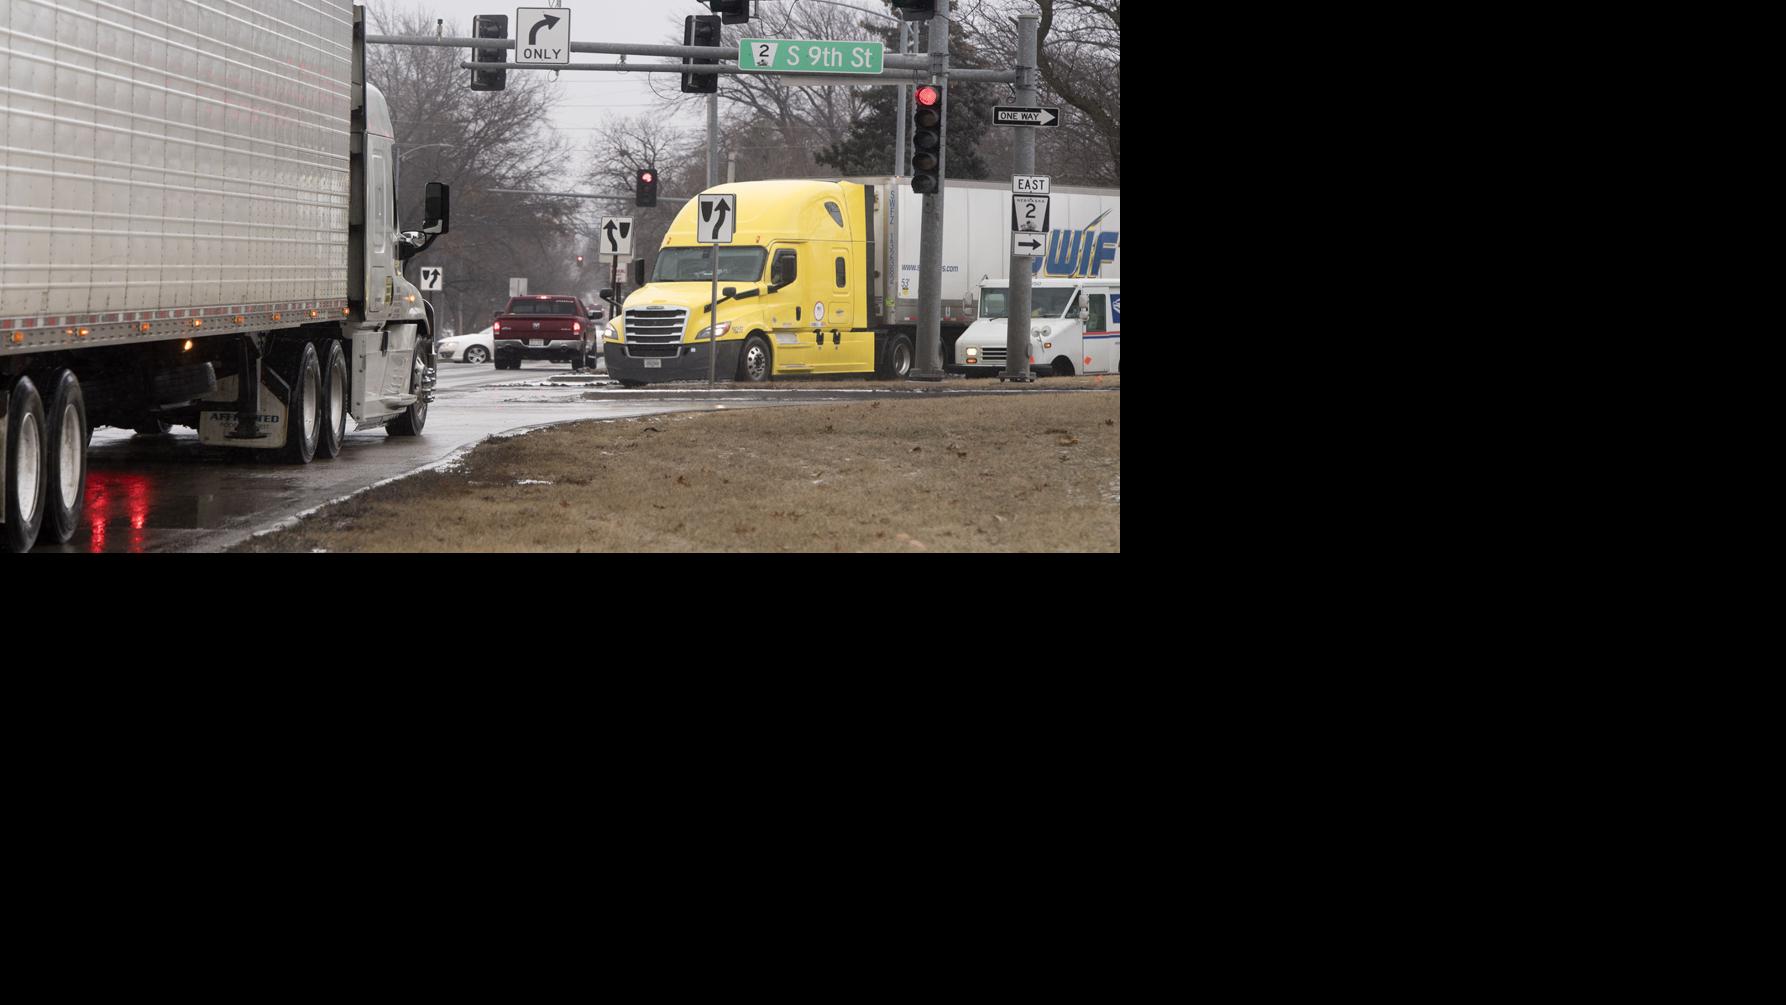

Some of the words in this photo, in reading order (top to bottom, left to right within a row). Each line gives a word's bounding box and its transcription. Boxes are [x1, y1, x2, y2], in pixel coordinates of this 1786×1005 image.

[523, 48, 562, 60] ONLY
[758, 44, 770, 58] 2
[786, 45, 801, 66] S
[807, 46, 843, 67] 9th
[850, 47, 873, 68] St
[1000, 112, 1018, 120] ONE
[1020, 112, 1040, 121] WAY
[1018, 179, 1045, 190] EAST
[1025, 203, 1036, 218] 2
[1032, 229, 1120, 278] WIF
